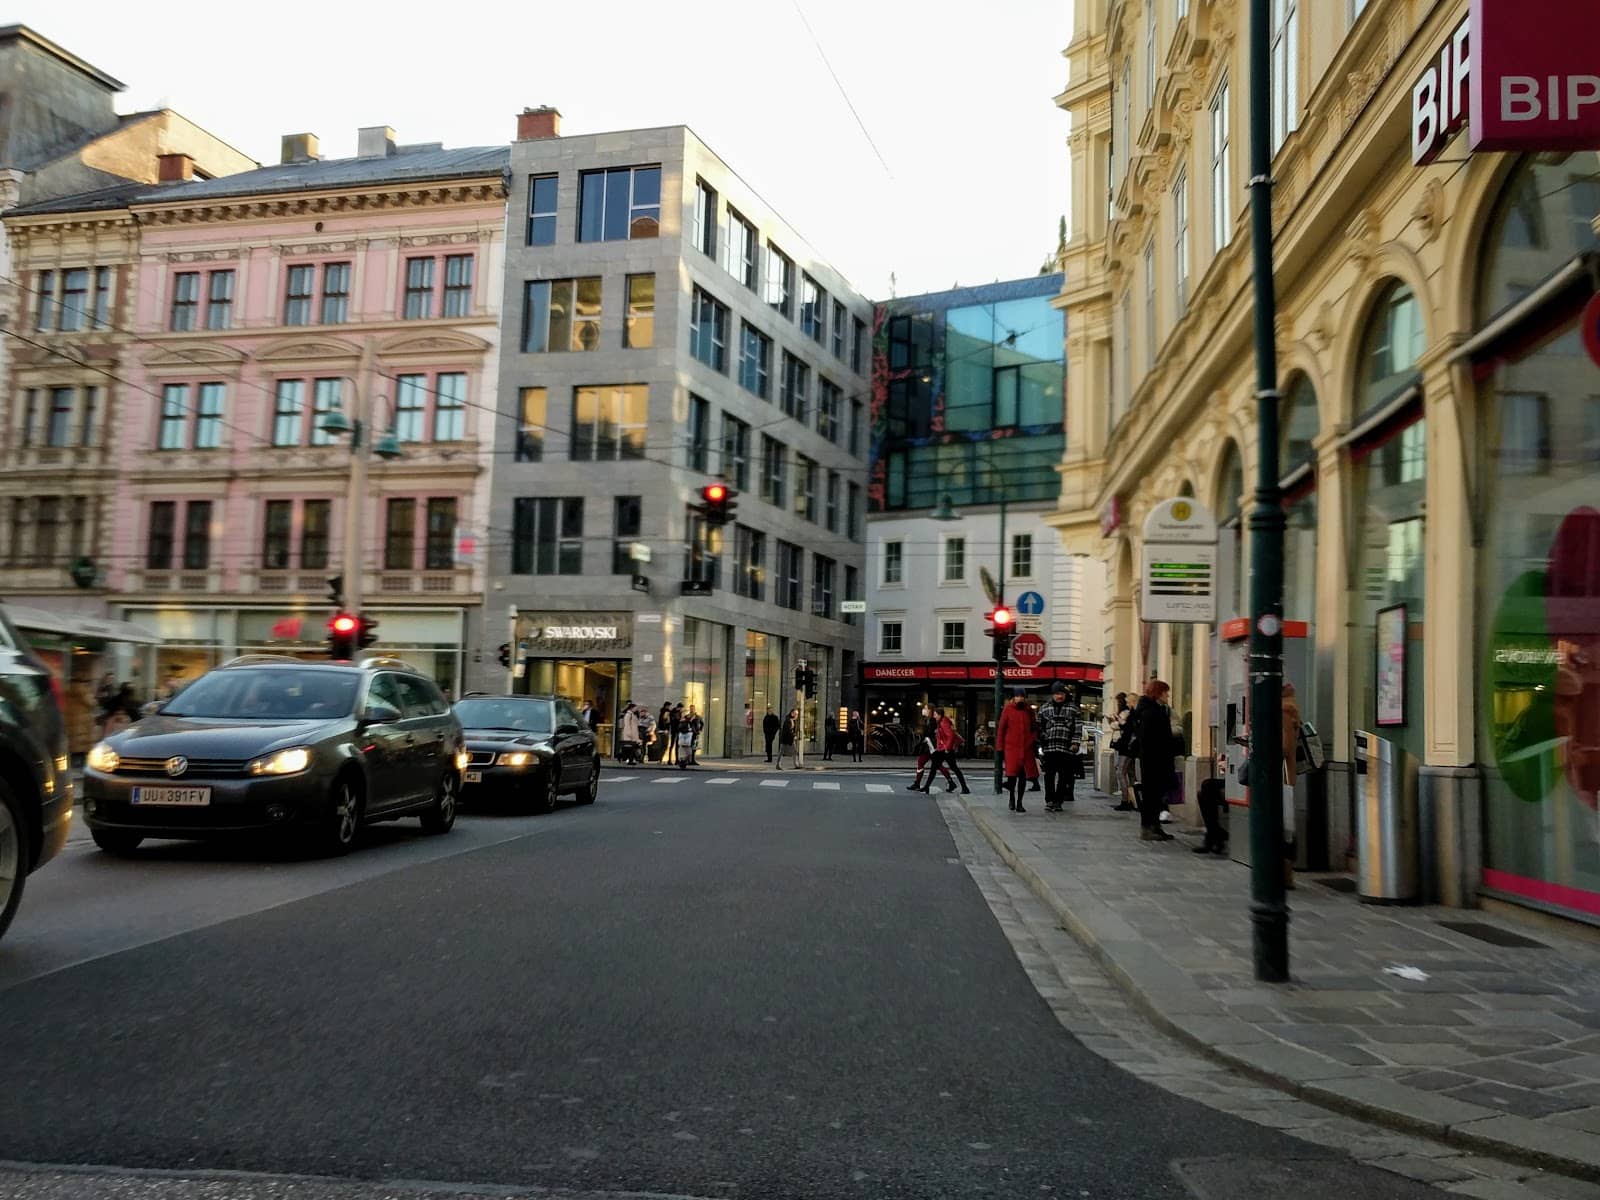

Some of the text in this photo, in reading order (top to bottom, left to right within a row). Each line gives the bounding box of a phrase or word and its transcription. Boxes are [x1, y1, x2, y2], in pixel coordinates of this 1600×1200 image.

[544, 626, 617, 639] SWAROVSKI
[1014, 643, 1044, 656] STOP
[875, 668, 915, 677] DANECKER
